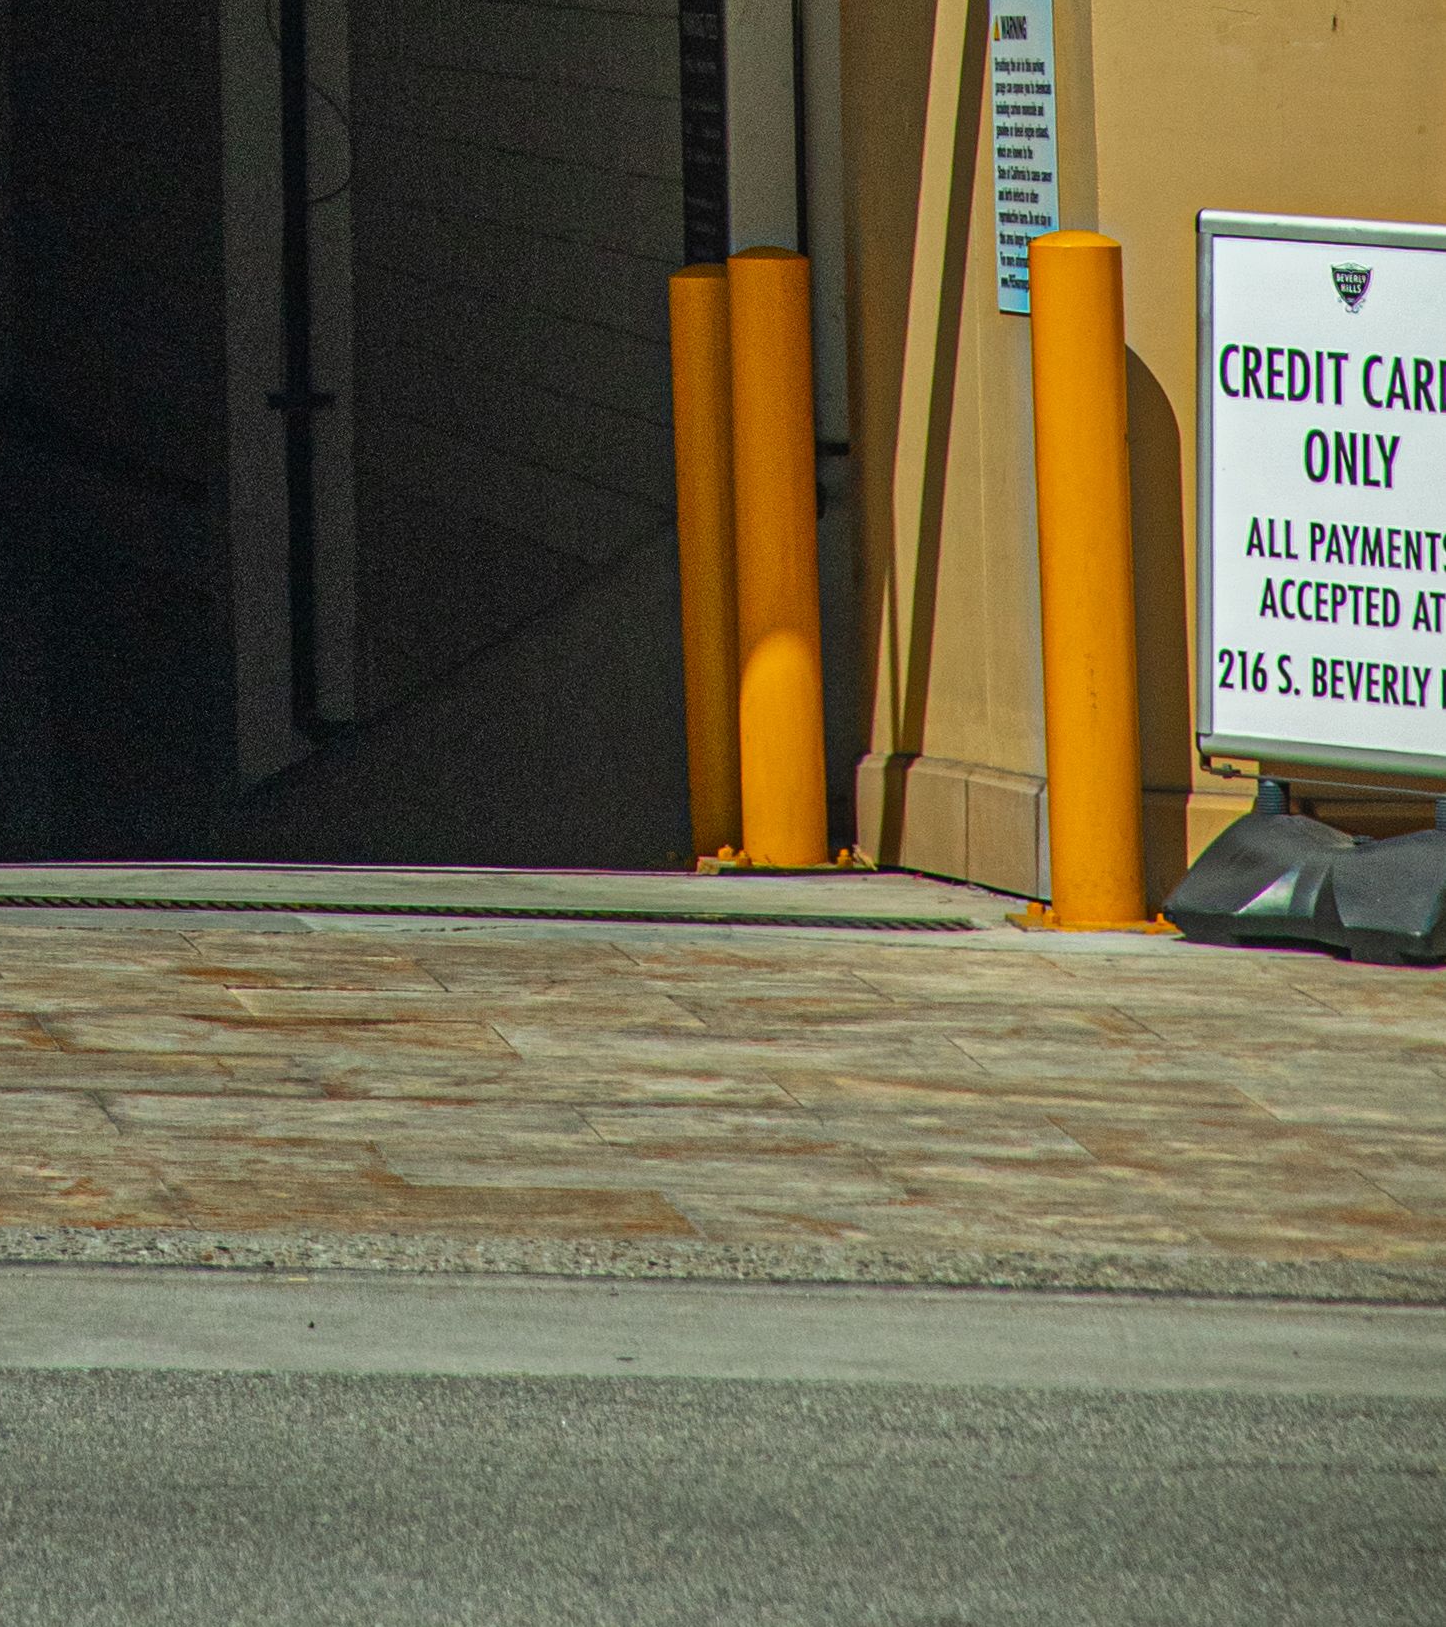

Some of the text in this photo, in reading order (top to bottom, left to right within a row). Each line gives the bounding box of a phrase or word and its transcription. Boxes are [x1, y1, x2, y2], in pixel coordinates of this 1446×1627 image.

[1219, 343, 1446, 413] CREDIT CAR
[1304, 429, 1401, 489] ONLY
[1246, 517, 1446, 573] ALL PAYMENT
[1259, 577, 1446, 633] ACCEPTED AT
[1218, 648, 1268, 693] 216
[1277, 654, 1301, 696] S.
[1312, 657, 1432, 708] BEVERLY
